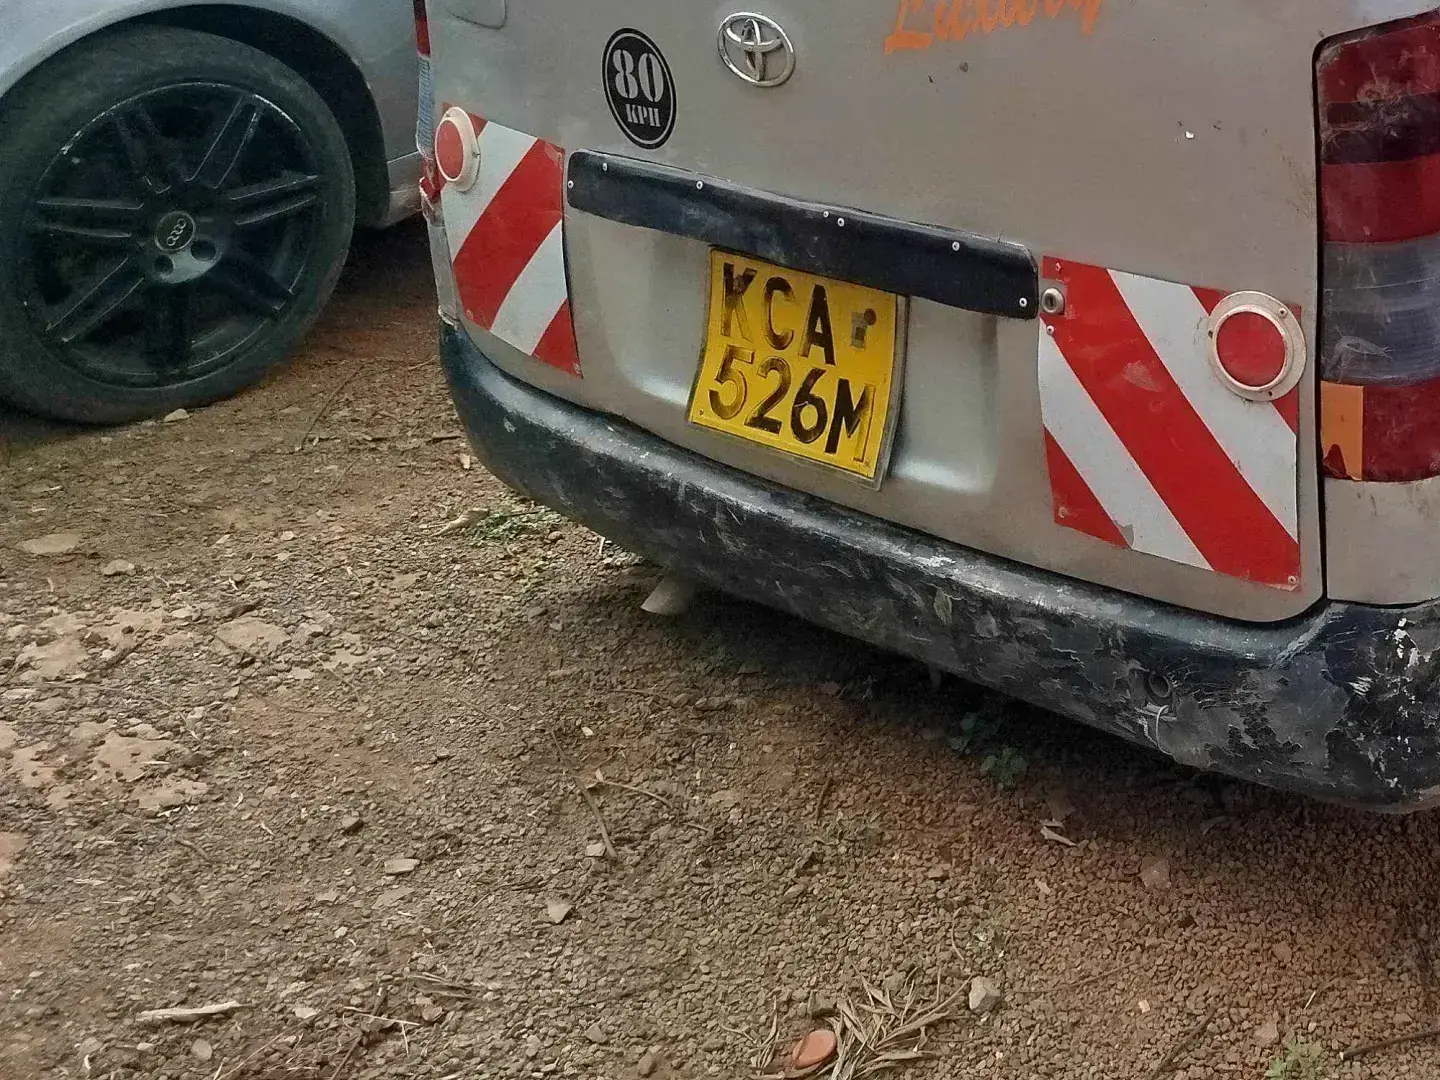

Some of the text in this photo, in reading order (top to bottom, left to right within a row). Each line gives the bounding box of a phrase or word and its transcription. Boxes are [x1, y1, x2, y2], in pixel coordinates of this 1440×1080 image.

[612, 49, 664, 102] 80
[625, 103, 661, 127] KPH
[720, 262, 836, 366] KCA
[708, 343, 876, 463] 526M
